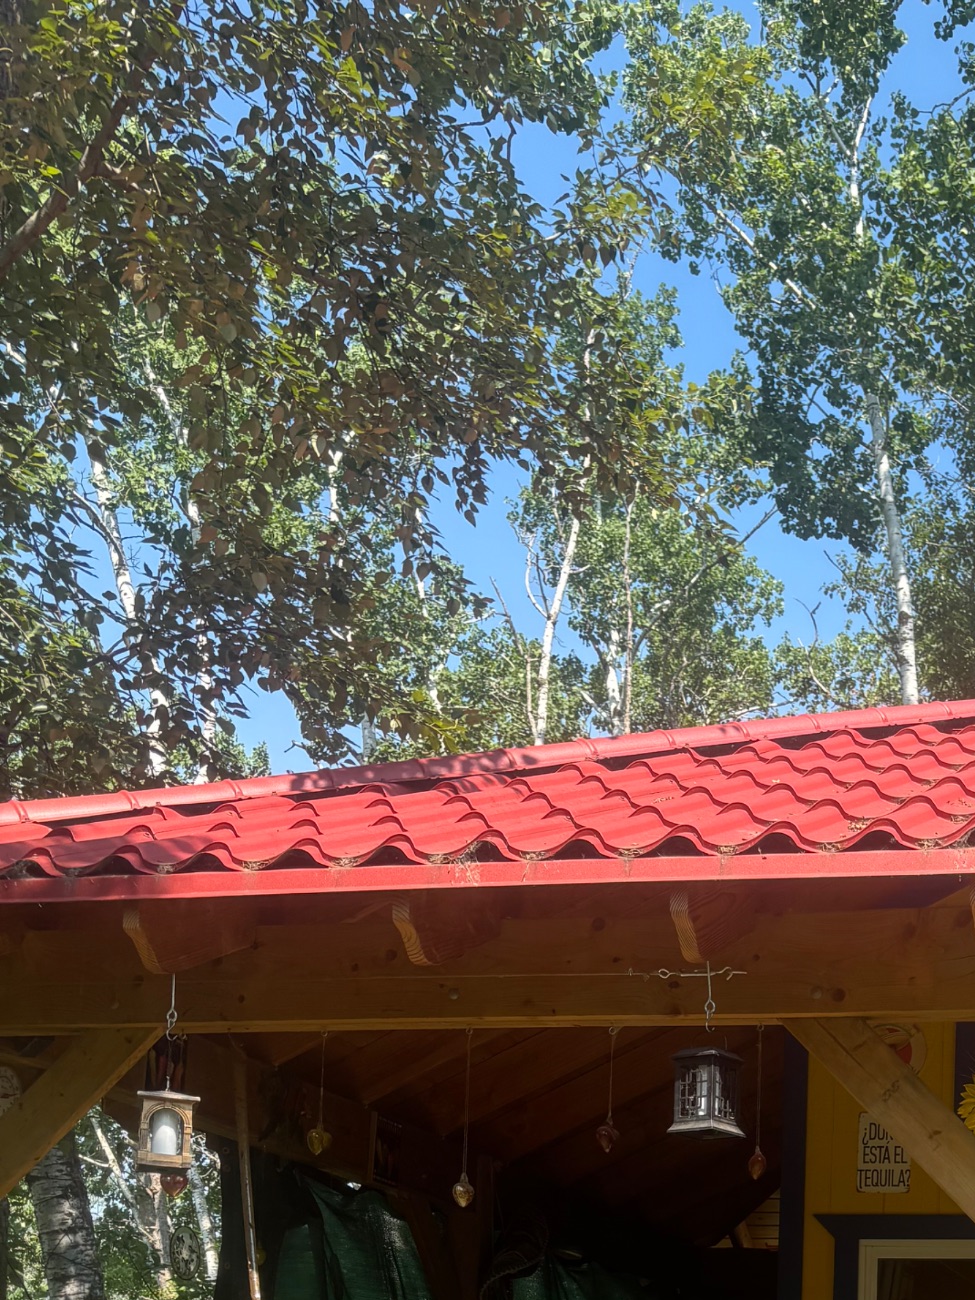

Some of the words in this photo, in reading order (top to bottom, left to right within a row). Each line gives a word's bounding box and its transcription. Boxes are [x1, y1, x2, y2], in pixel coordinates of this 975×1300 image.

[863, 1141, 891, 1164] ESTÁ
[894, 1145, 908, 1164] EL
[857, 1169, 911, 1189] TEQUILA?
